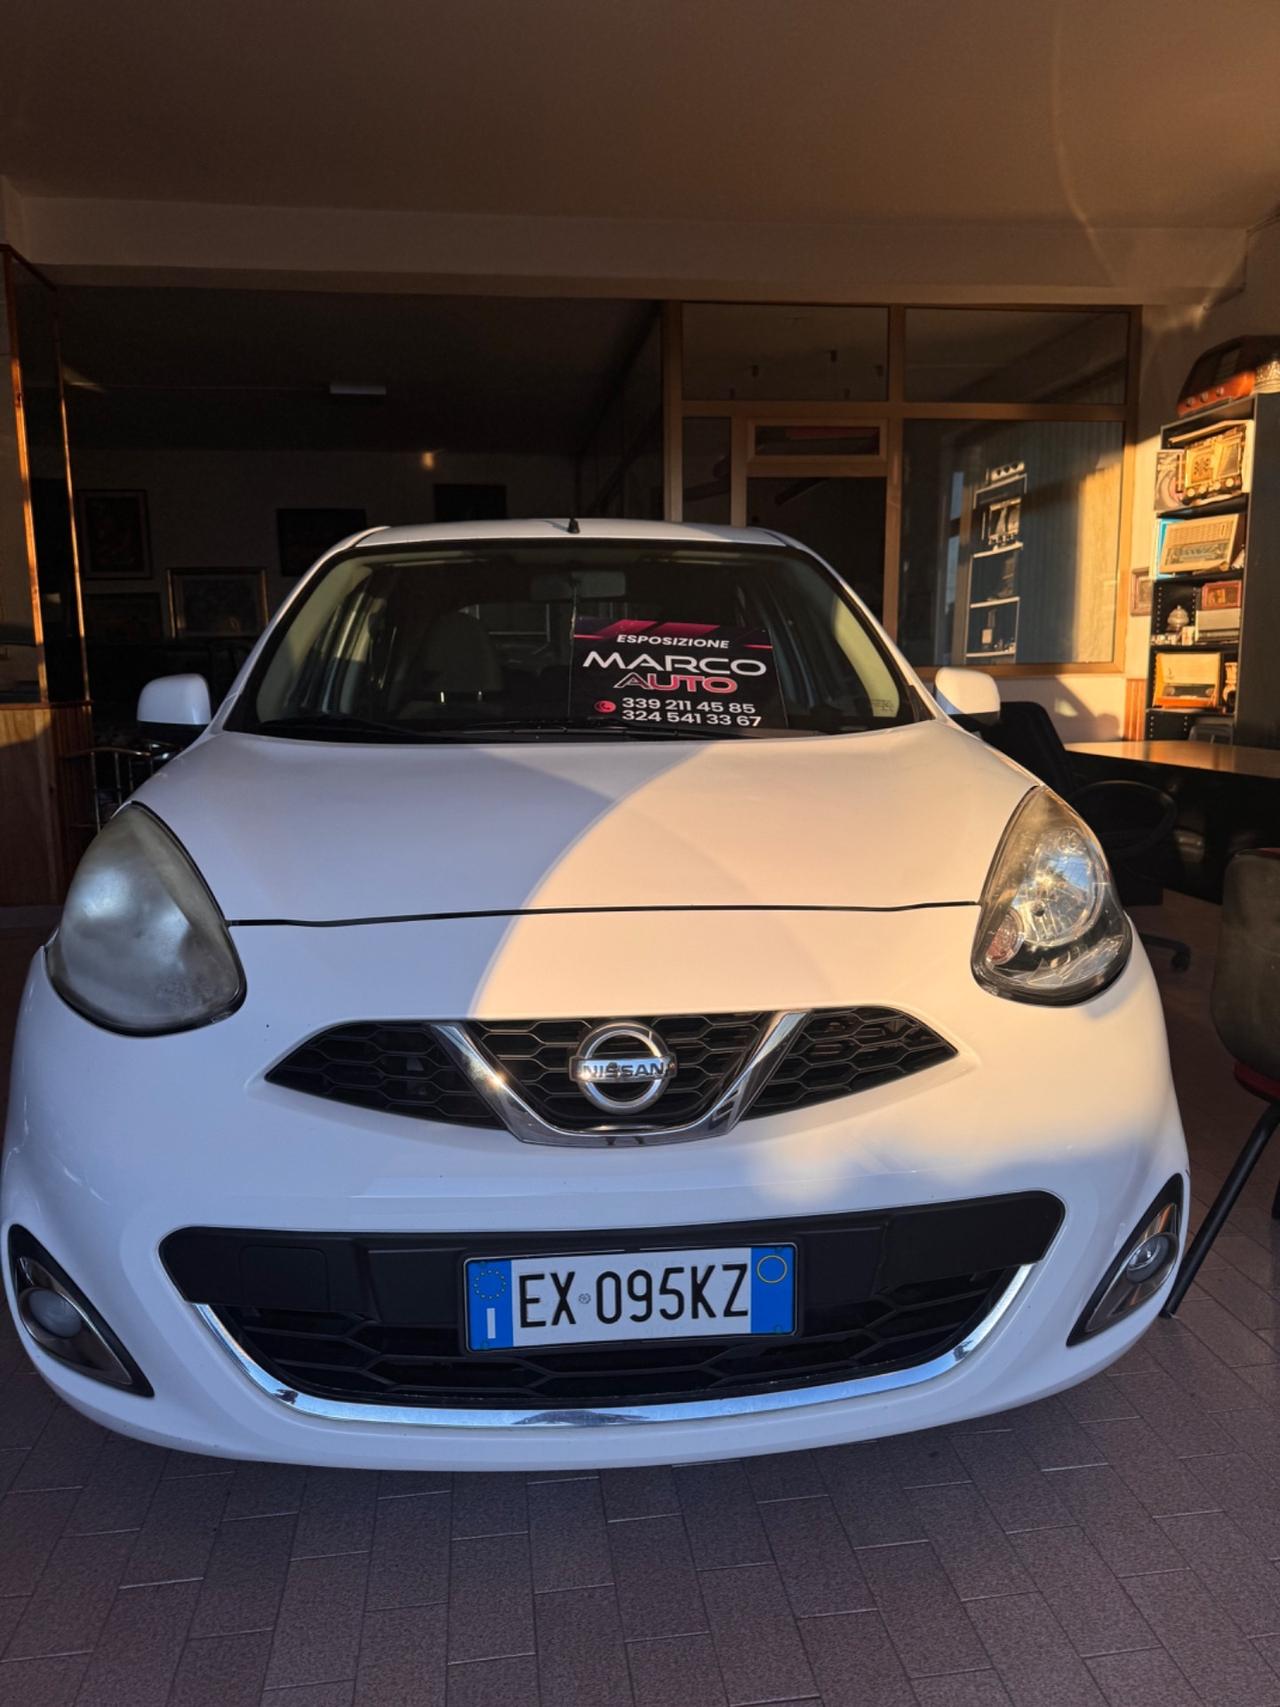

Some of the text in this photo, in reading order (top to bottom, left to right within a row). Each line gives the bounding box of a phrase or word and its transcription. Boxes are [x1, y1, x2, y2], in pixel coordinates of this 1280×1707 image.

[616, 634, 730, 649] ESPOSIZIONE
[583, 651, 767, 676] MARCO
[613, 671, 738, 694] AUTO
[622, 697, 756, 714] 339 211 45 85
[622, 710, 762, 727] 324 541 33 67
[583, 1062, 665, 1078] NISSAN
[518, 1263, 748, 1328] EX 095KZ
